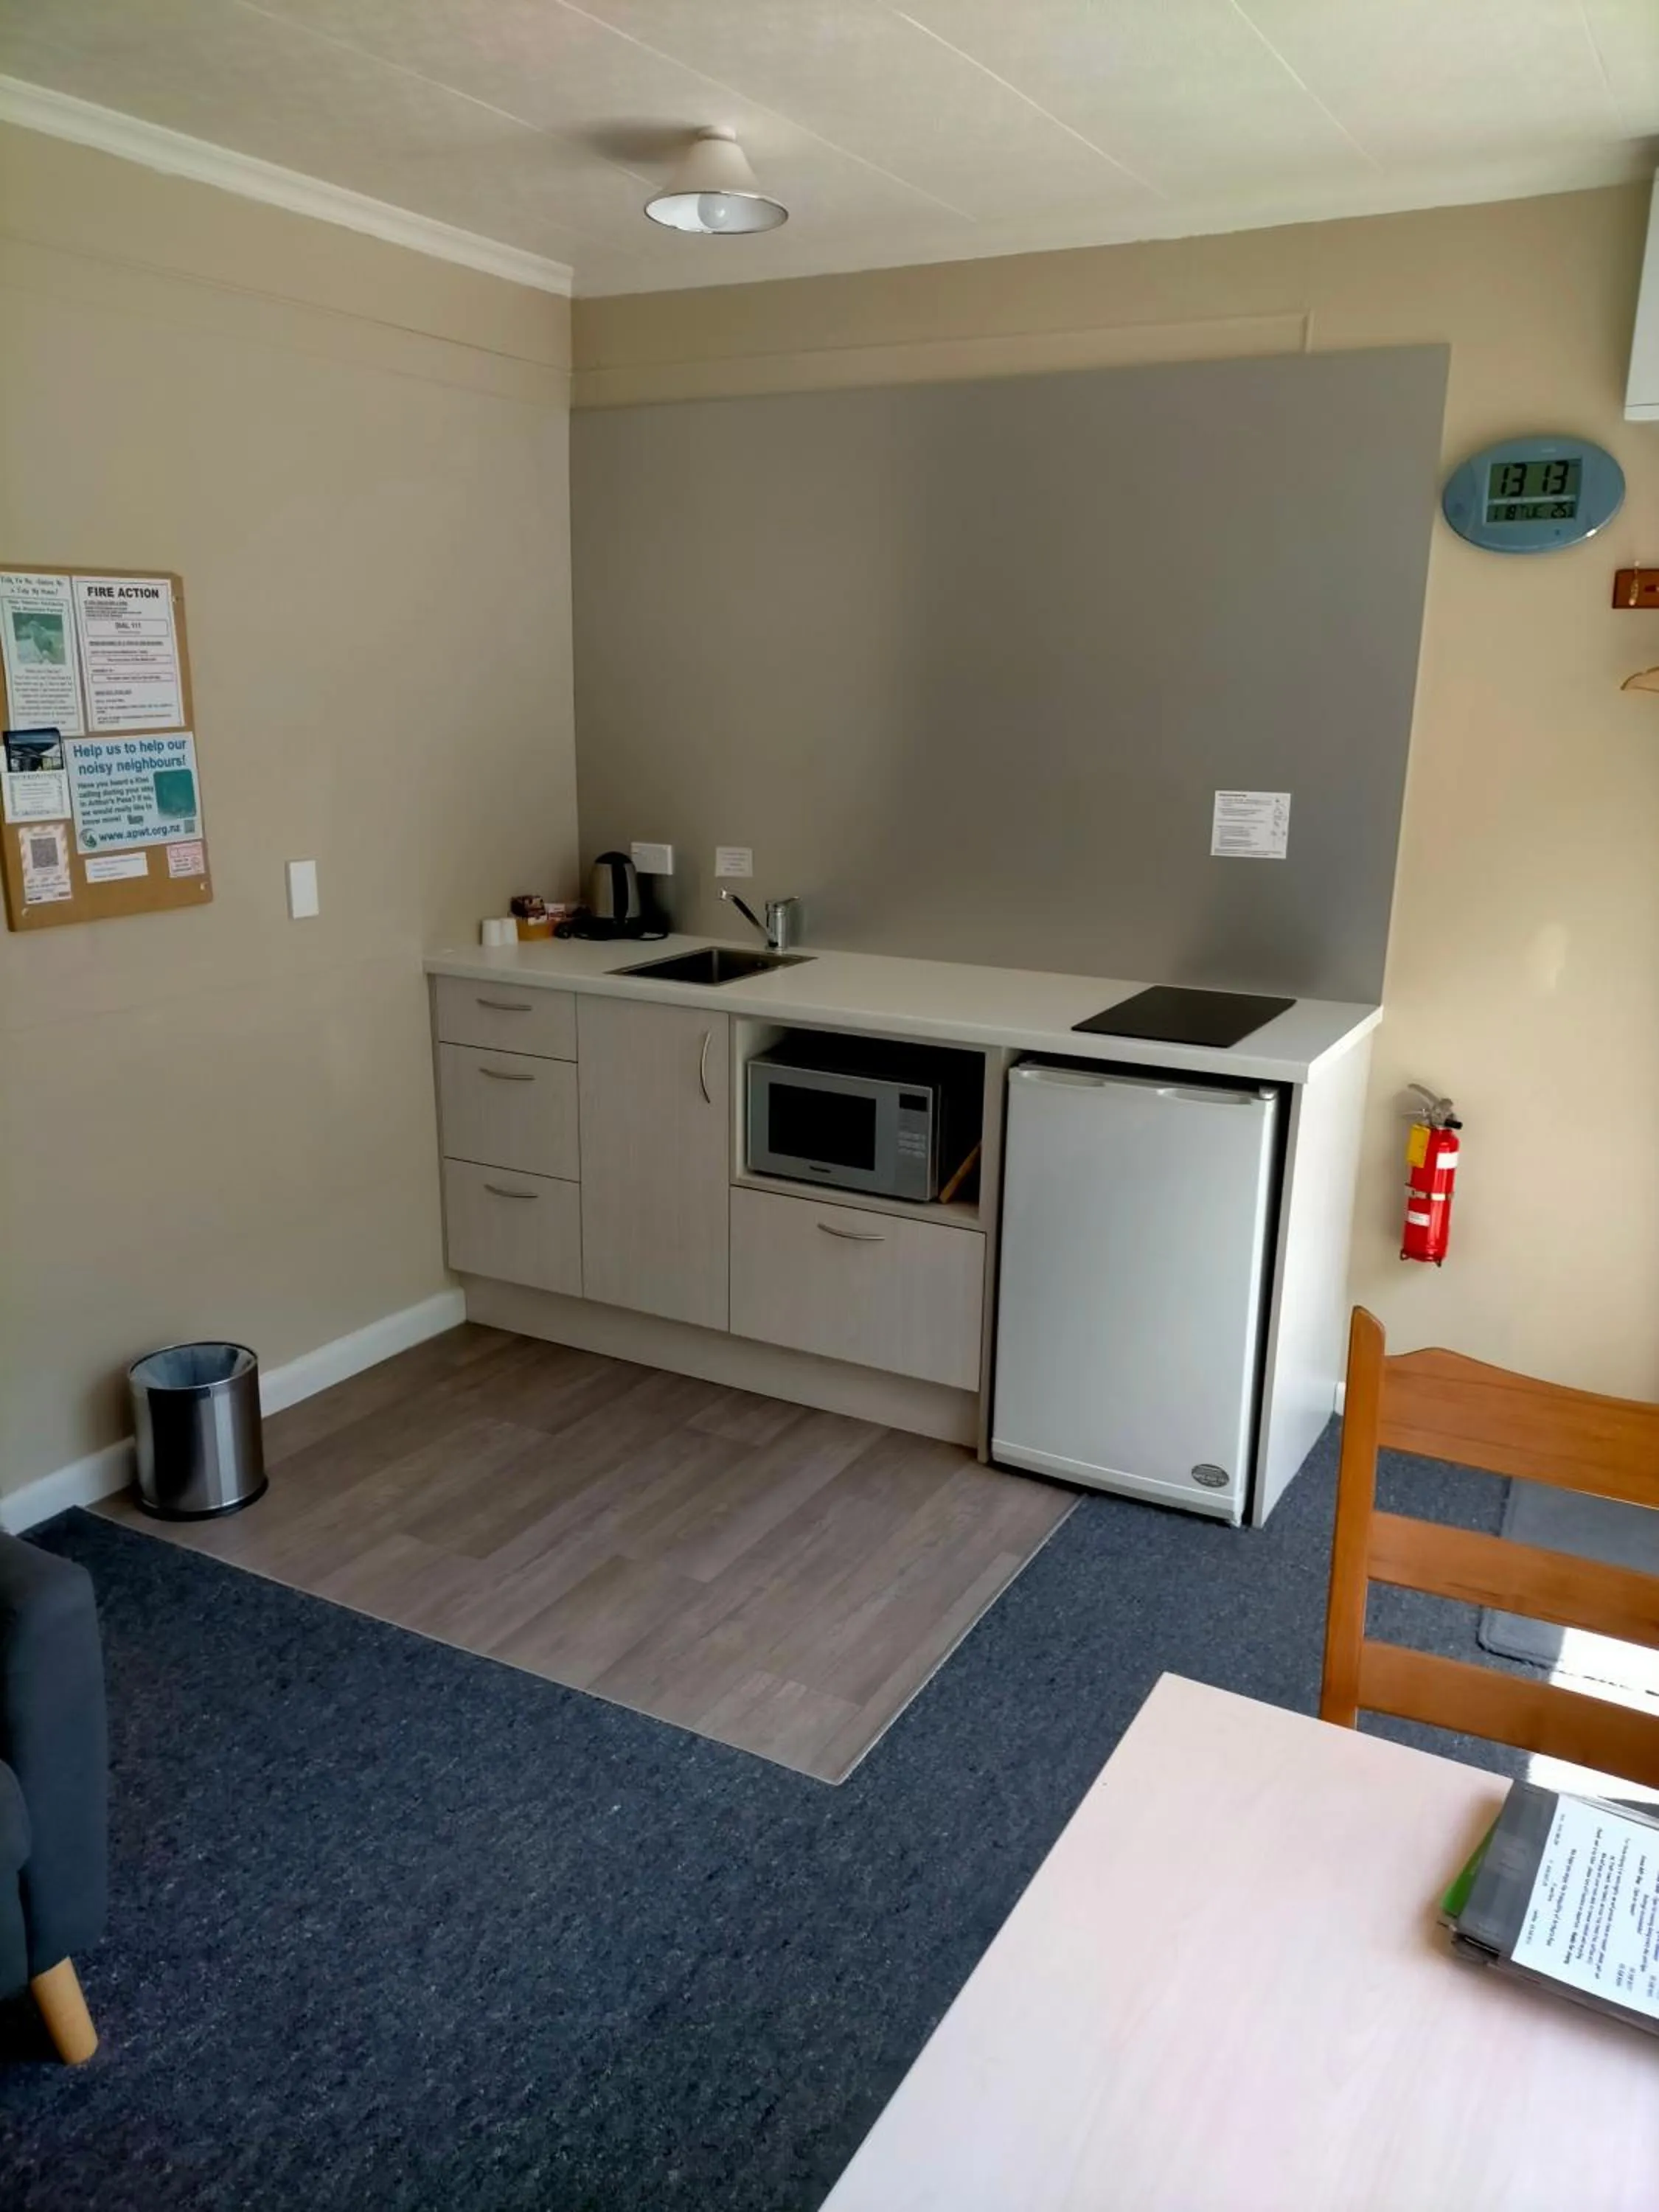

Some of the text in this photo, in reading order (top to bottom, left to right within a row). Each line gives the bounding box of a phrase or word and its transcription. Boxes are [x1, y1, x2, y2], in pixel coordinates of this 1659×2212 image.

[86, 586, 159, 599] FIRE ACTION
[73, 740, 187, 758] Help us to help our
[78, 754, 186, 775] noisy neighbours!
